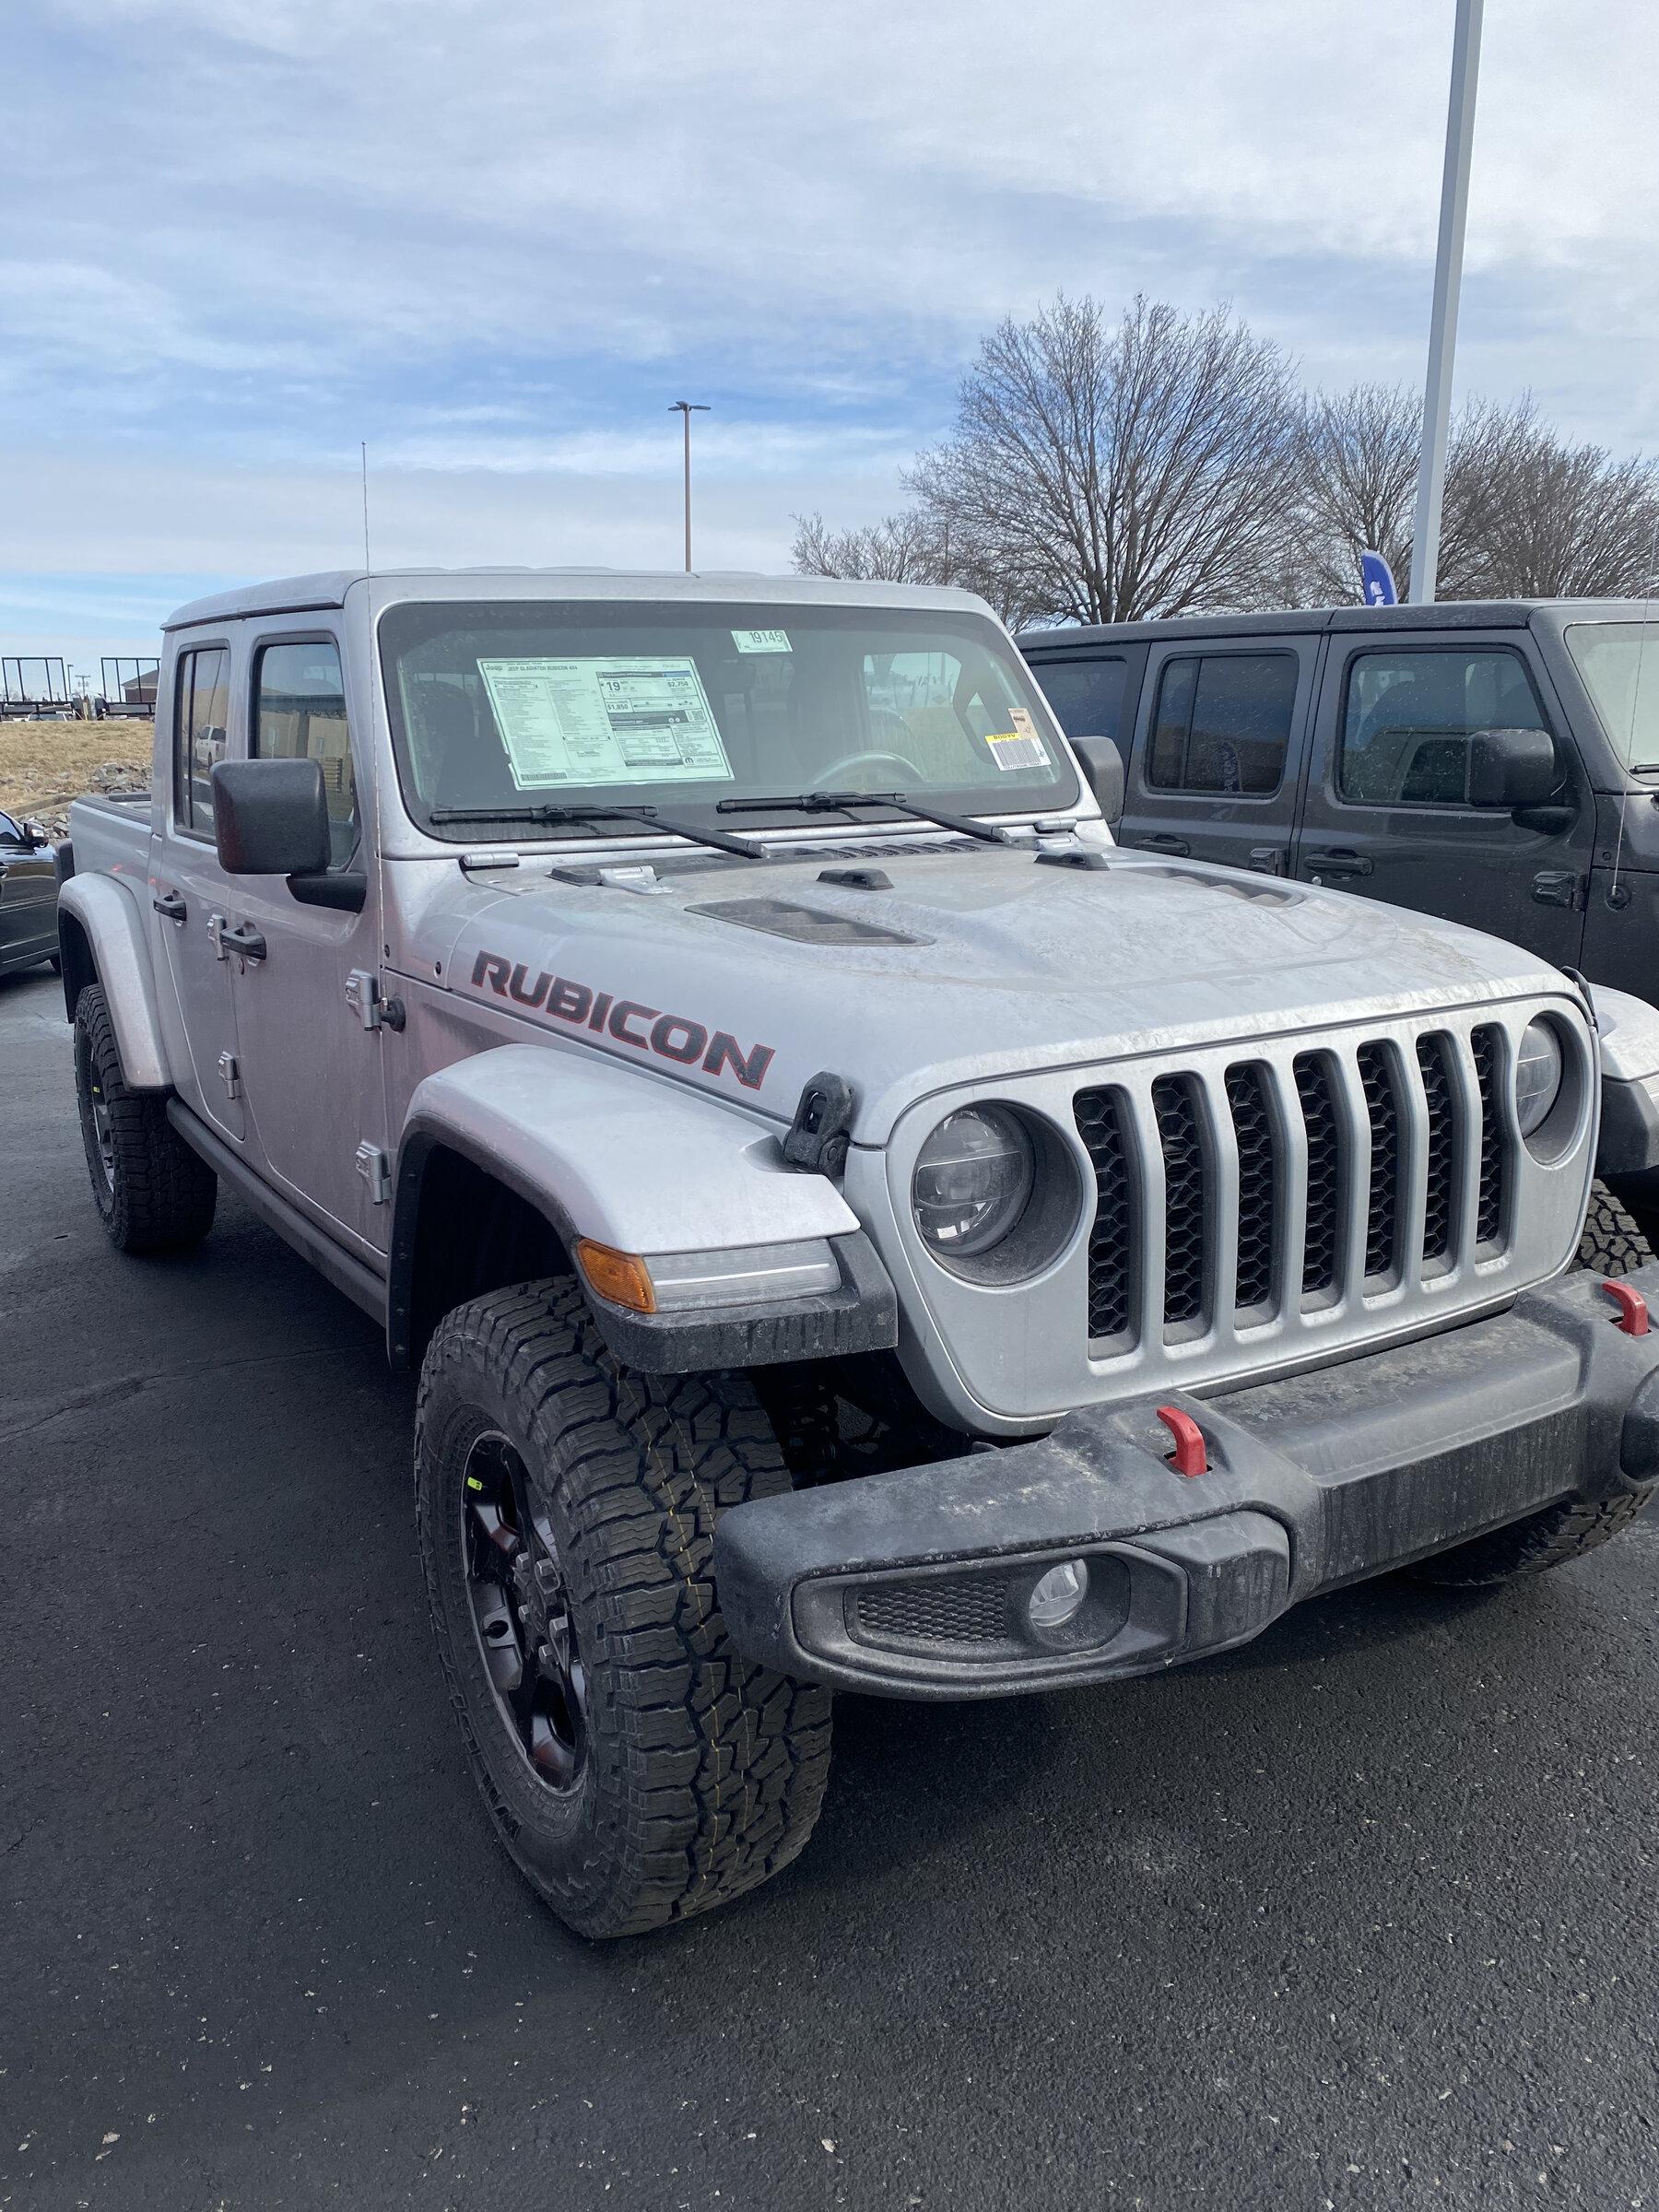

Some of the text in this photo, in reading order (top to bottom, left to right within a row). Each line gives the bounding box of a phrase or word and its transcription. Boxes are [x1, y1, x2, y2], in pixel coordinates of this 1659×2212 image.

[749, 631, 783, 642] 19145
[606, 681, 620, 690] 19
[471, 950, 776, 1090] RUBICON
